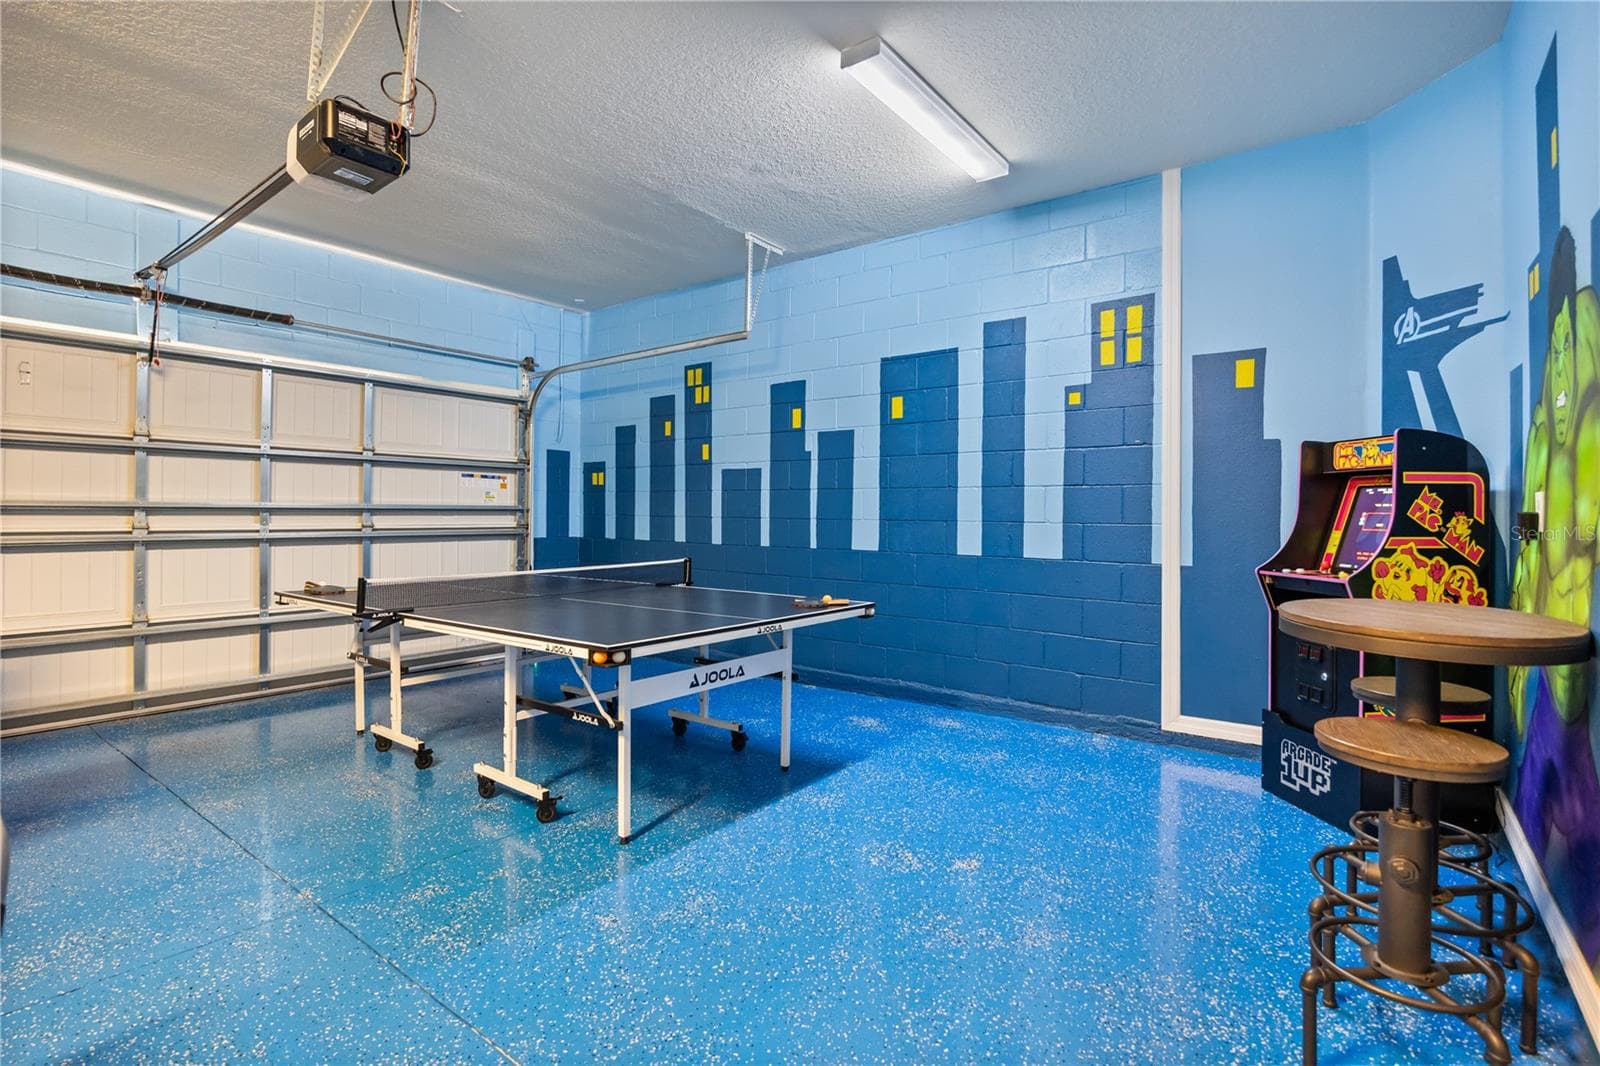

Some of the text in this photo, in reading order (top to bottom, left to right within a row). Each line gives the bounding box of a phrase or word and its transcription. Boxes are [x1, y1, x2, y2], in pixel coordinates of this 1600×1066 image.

[762, 624, 783, 634] JOOLA
[551, 644, 574, 656] JOOLA
[701, 664, 746, 686] JOOLA
[577, 712, 599, 726] JOOLA
[1280, 738, 1331, 776] ARCADE
